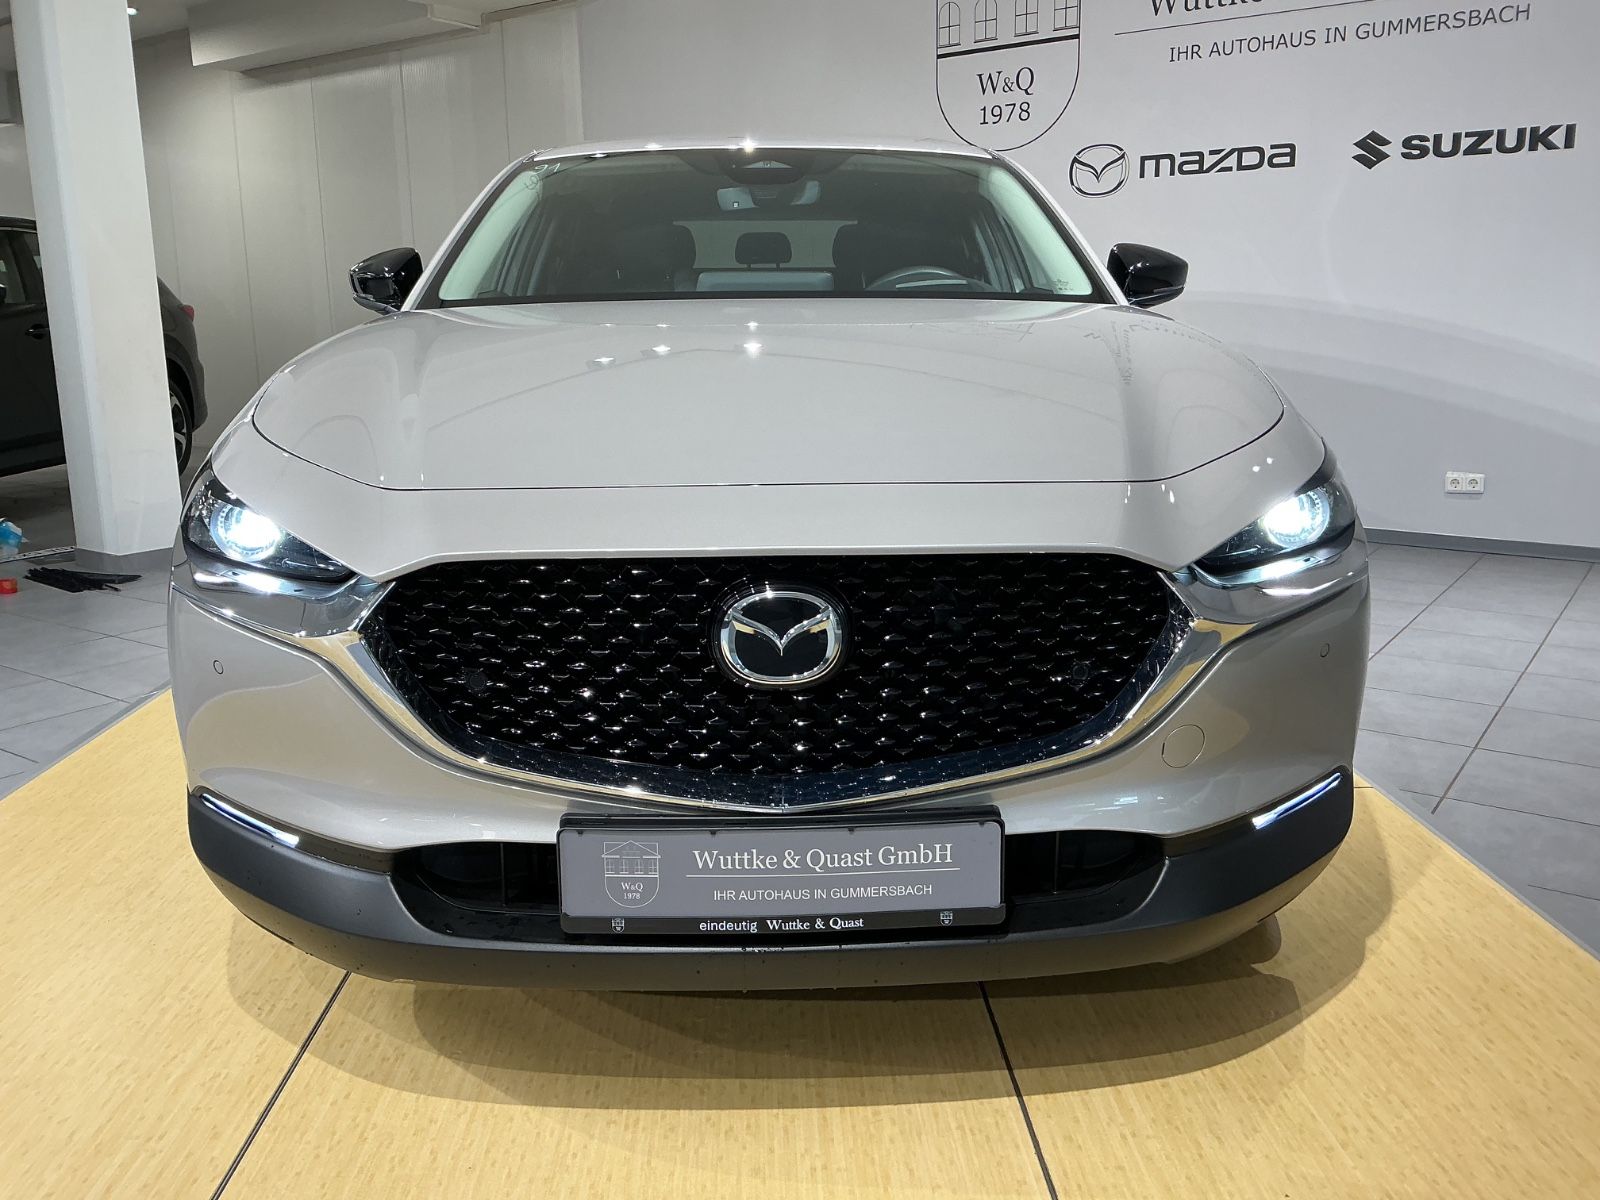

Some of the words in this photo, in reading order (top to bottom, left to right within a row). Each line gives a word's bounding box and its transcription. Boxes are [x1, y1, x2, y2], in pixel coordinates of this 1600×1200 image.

[1169, 44, 1203, 63] IHR
[1208, 29, 1317, 58] AUTOHAUS
[1324, 25, 1347, 44] IN
[1355, 3, 1531, 40] GUMMERSBACH
[976, 66, 1034, 96] W&Q
[979, 101, 1031, 125] 1978
[1400, 123, 1578, 161] SUZUKI
[692, 848, 778, 870] Wuttke
[782, 849, 802, 869] &
[806, 848, 873, 873] Quast
[878, 843, 954, 866] GmbH
[621, 881, 644, 893] W&Q
[623, 892, 641, 900] 1978
[713, 889, 736, 901] IHR
[738, 888, 811, 901] AUTOHAUS
[813, 888, 828, 900] IN
[830, 883, 933, 899] GUMMERSBACH
[699, 920, 758, 933] eindeutig
[766, 918, 811, 931] Wuttke
[814, 917, 826, 930] &
[829, 916, 865, 930] Quast
